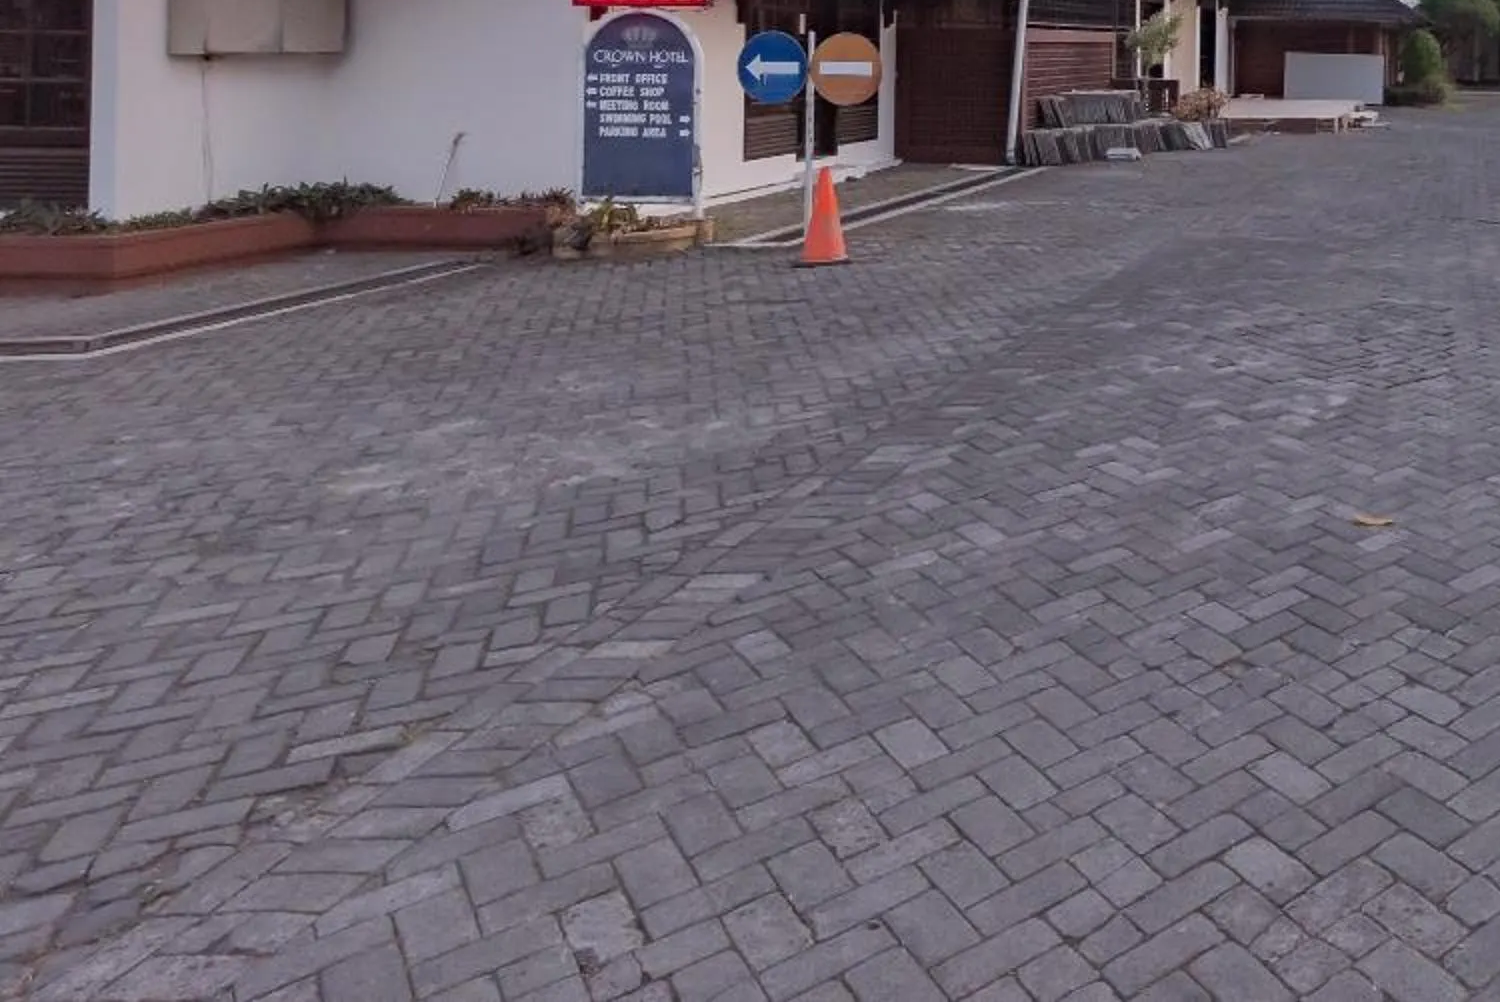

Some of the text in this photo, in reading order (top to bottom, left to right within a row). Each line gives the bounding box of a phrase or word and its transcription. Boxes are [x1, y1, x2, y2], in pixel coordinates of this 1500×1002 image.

[593, 49, 689, 64] CROWN HOTEL
[600, 73, 668, 85] FRONT OFFICE
[600, 86, 665, 97] COFFEE SHOP
[599, 99, 669, 111] MEETING ROOM
[599, 113, 672, 125] SWIMMING POOL
[599, 126, 667, 138] PARKING AREA
